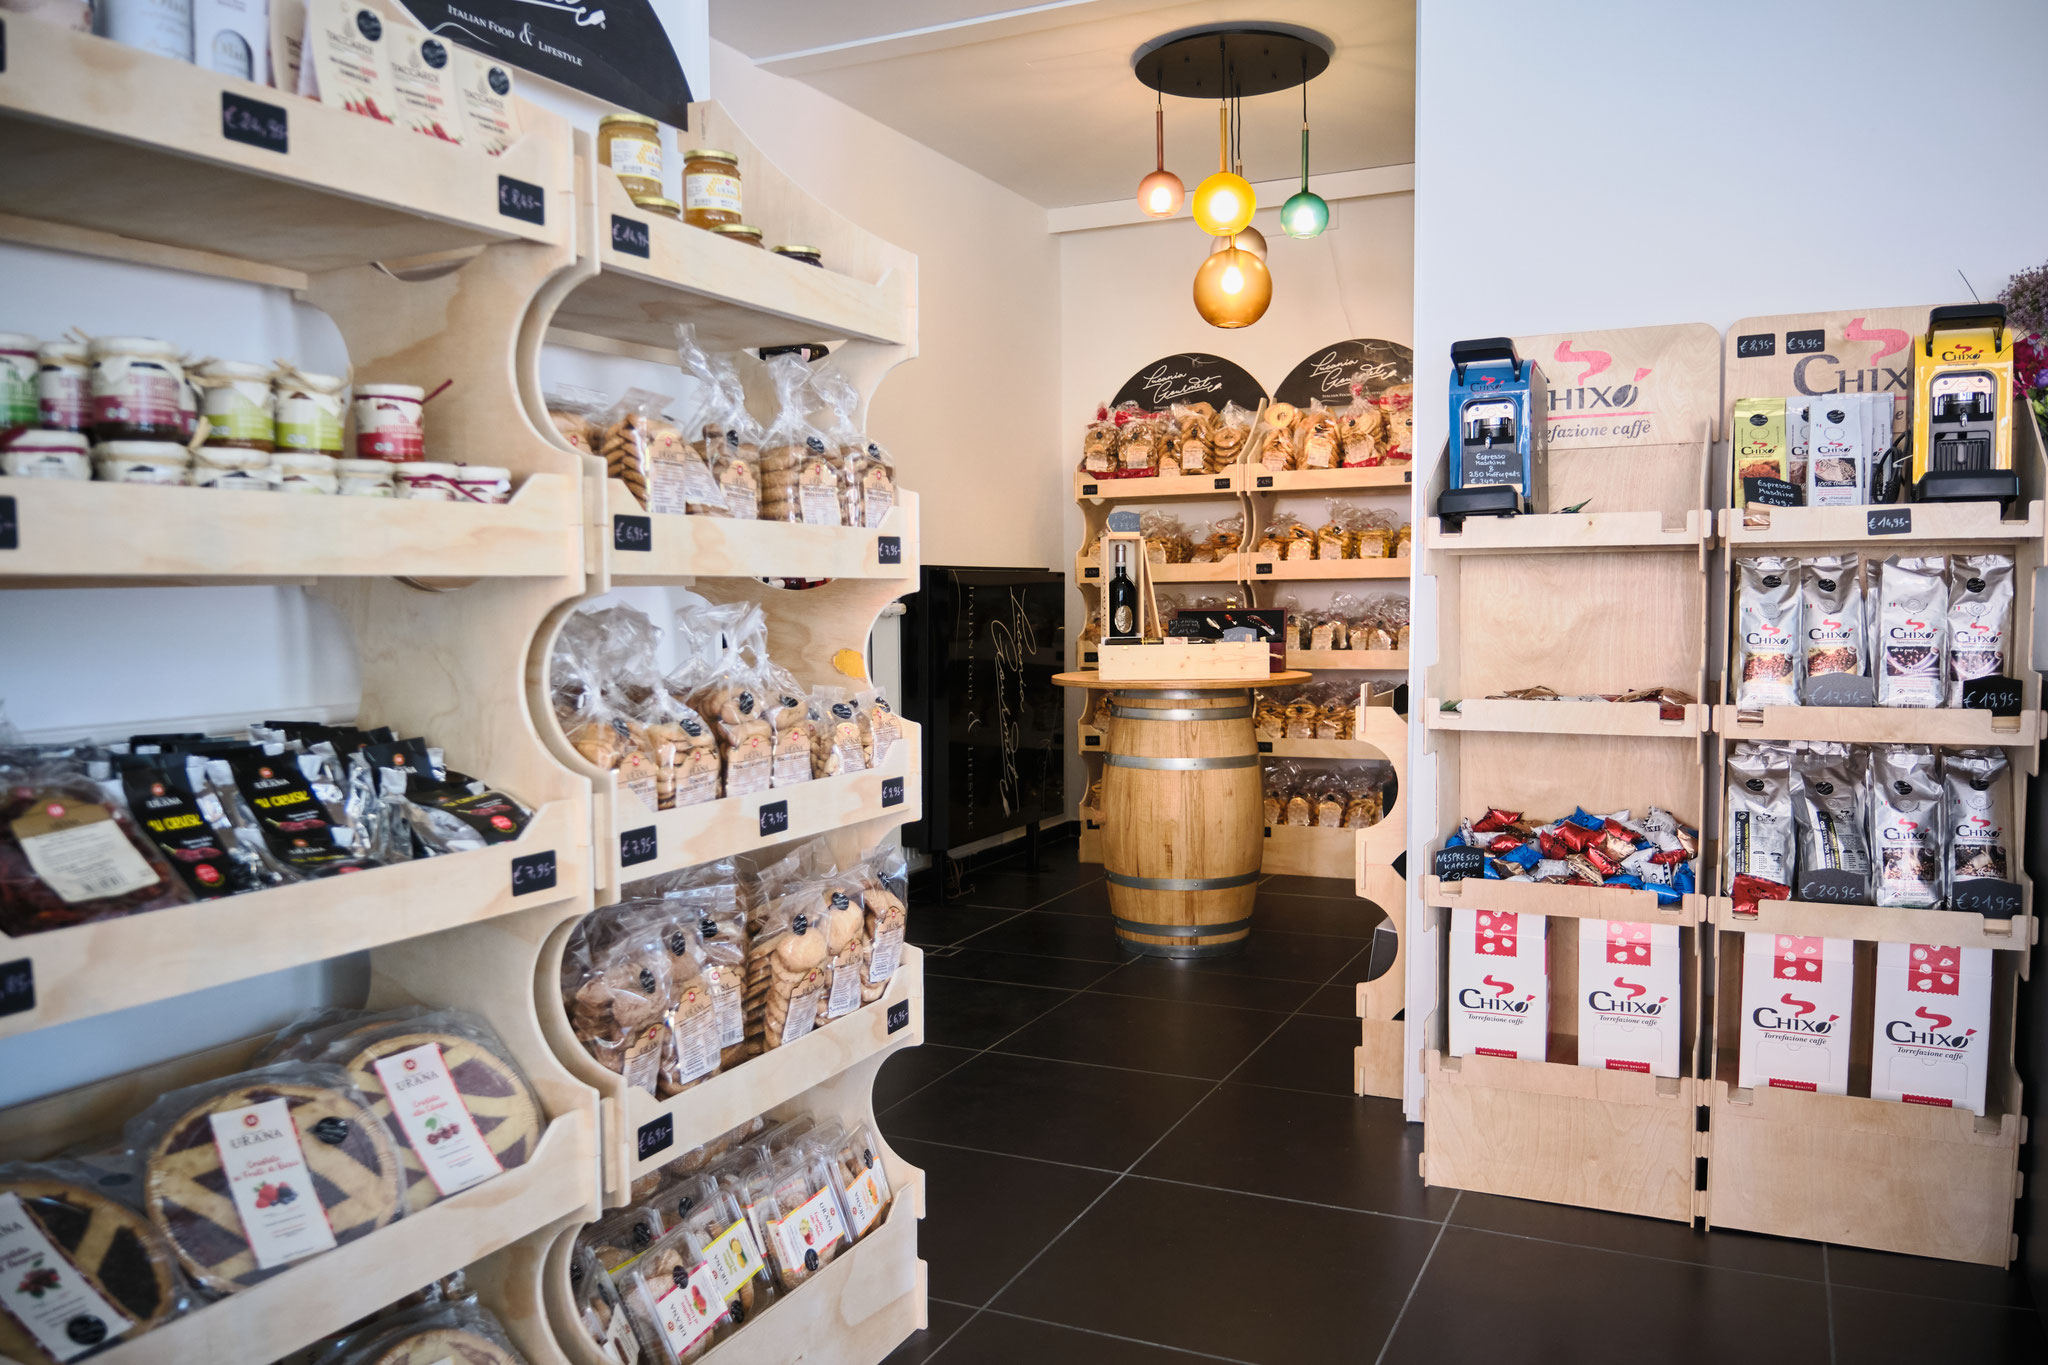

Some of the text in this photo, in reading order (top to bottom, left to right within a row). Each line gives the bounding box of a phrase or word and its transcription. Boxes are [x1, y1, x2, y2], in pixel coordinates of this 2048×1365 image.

[447, 4, 583, 66] ITALIAN FOOD & LIFESTYLE
[1793, 354, 1908, 397] CHIX
[1613, 419, 1651, 440] caffè
[1436, 852, 1480, 862] NESPRESSO
[1444, 861, 1480, 870] KAPSELN
[1468, 1012, 1507, 1023] Torrefazione
[1600, 1015, 1641, 1025] Torrefazione
[1764, 1032, 1827, 1045] Torrefazione caffè
[1897, 1046, 1964, 1060] Torrefazione caffè
[395, 1070, 440, 1091] URANA
[230, 1128, 284, 1150] URANA
